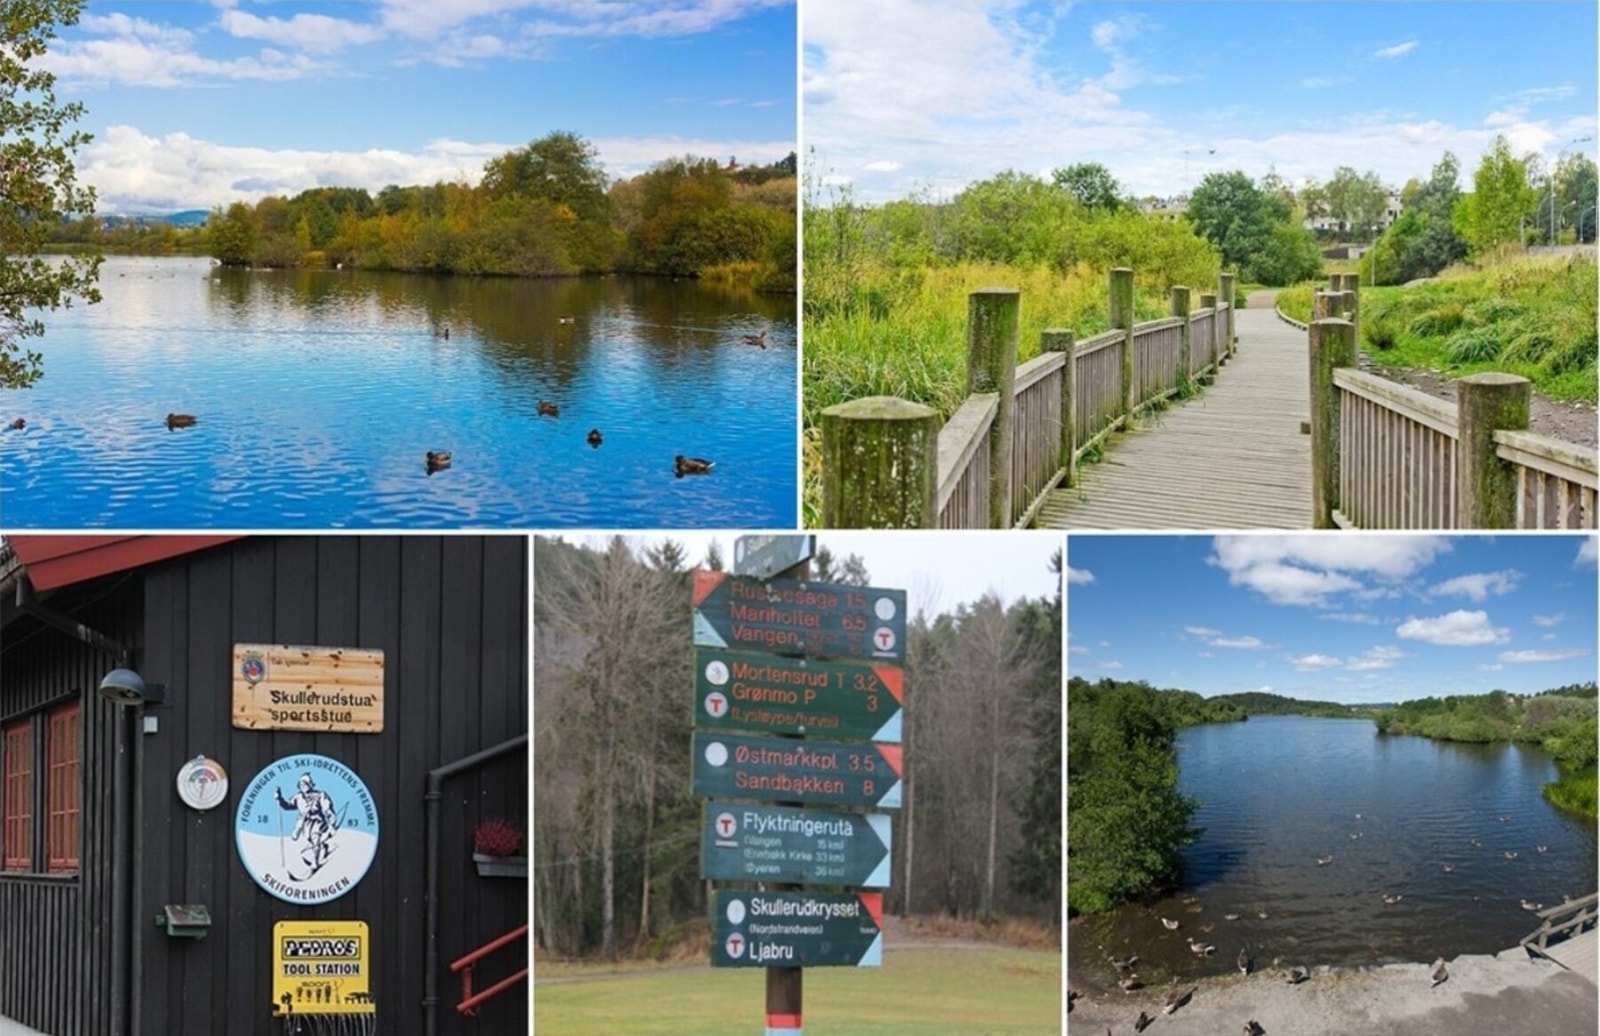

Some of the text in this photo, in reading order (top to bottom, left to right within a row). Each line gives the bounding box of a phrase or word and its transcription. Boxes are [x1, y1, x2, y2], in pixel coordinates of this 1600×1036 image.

[731, 604, 821, 628] Mariholtet
[731, 624, 799, 647] Vangen
[731, 662, 878, 693] Mortensrud T 3.2
[271, 690, 372, 707] Skullerudstua
[732, 682, 878, 712] Grønmo P 3
[271, 708, 352, 723] sportsstue
[848, 755, 876, 772] 3.5
[240, 758, 376, 827] FORENINGEN TIL SKI-IDRETTENS FREMME
[735, 771, 875, 796] Sandbakken 8
[257, 815, 269, 824] 18
[743, 812, 854, 837] Flyktningeruta
[261, 872, 350, 901] SKIFORENINGEN
[750, 897, 860, 920] Skullerudkrysset
[284, 939, 358, 957] PEDRO'S
[750, 941, 793, 962] Ljabru
[283, 963, 360, 975] TOOL STATION
